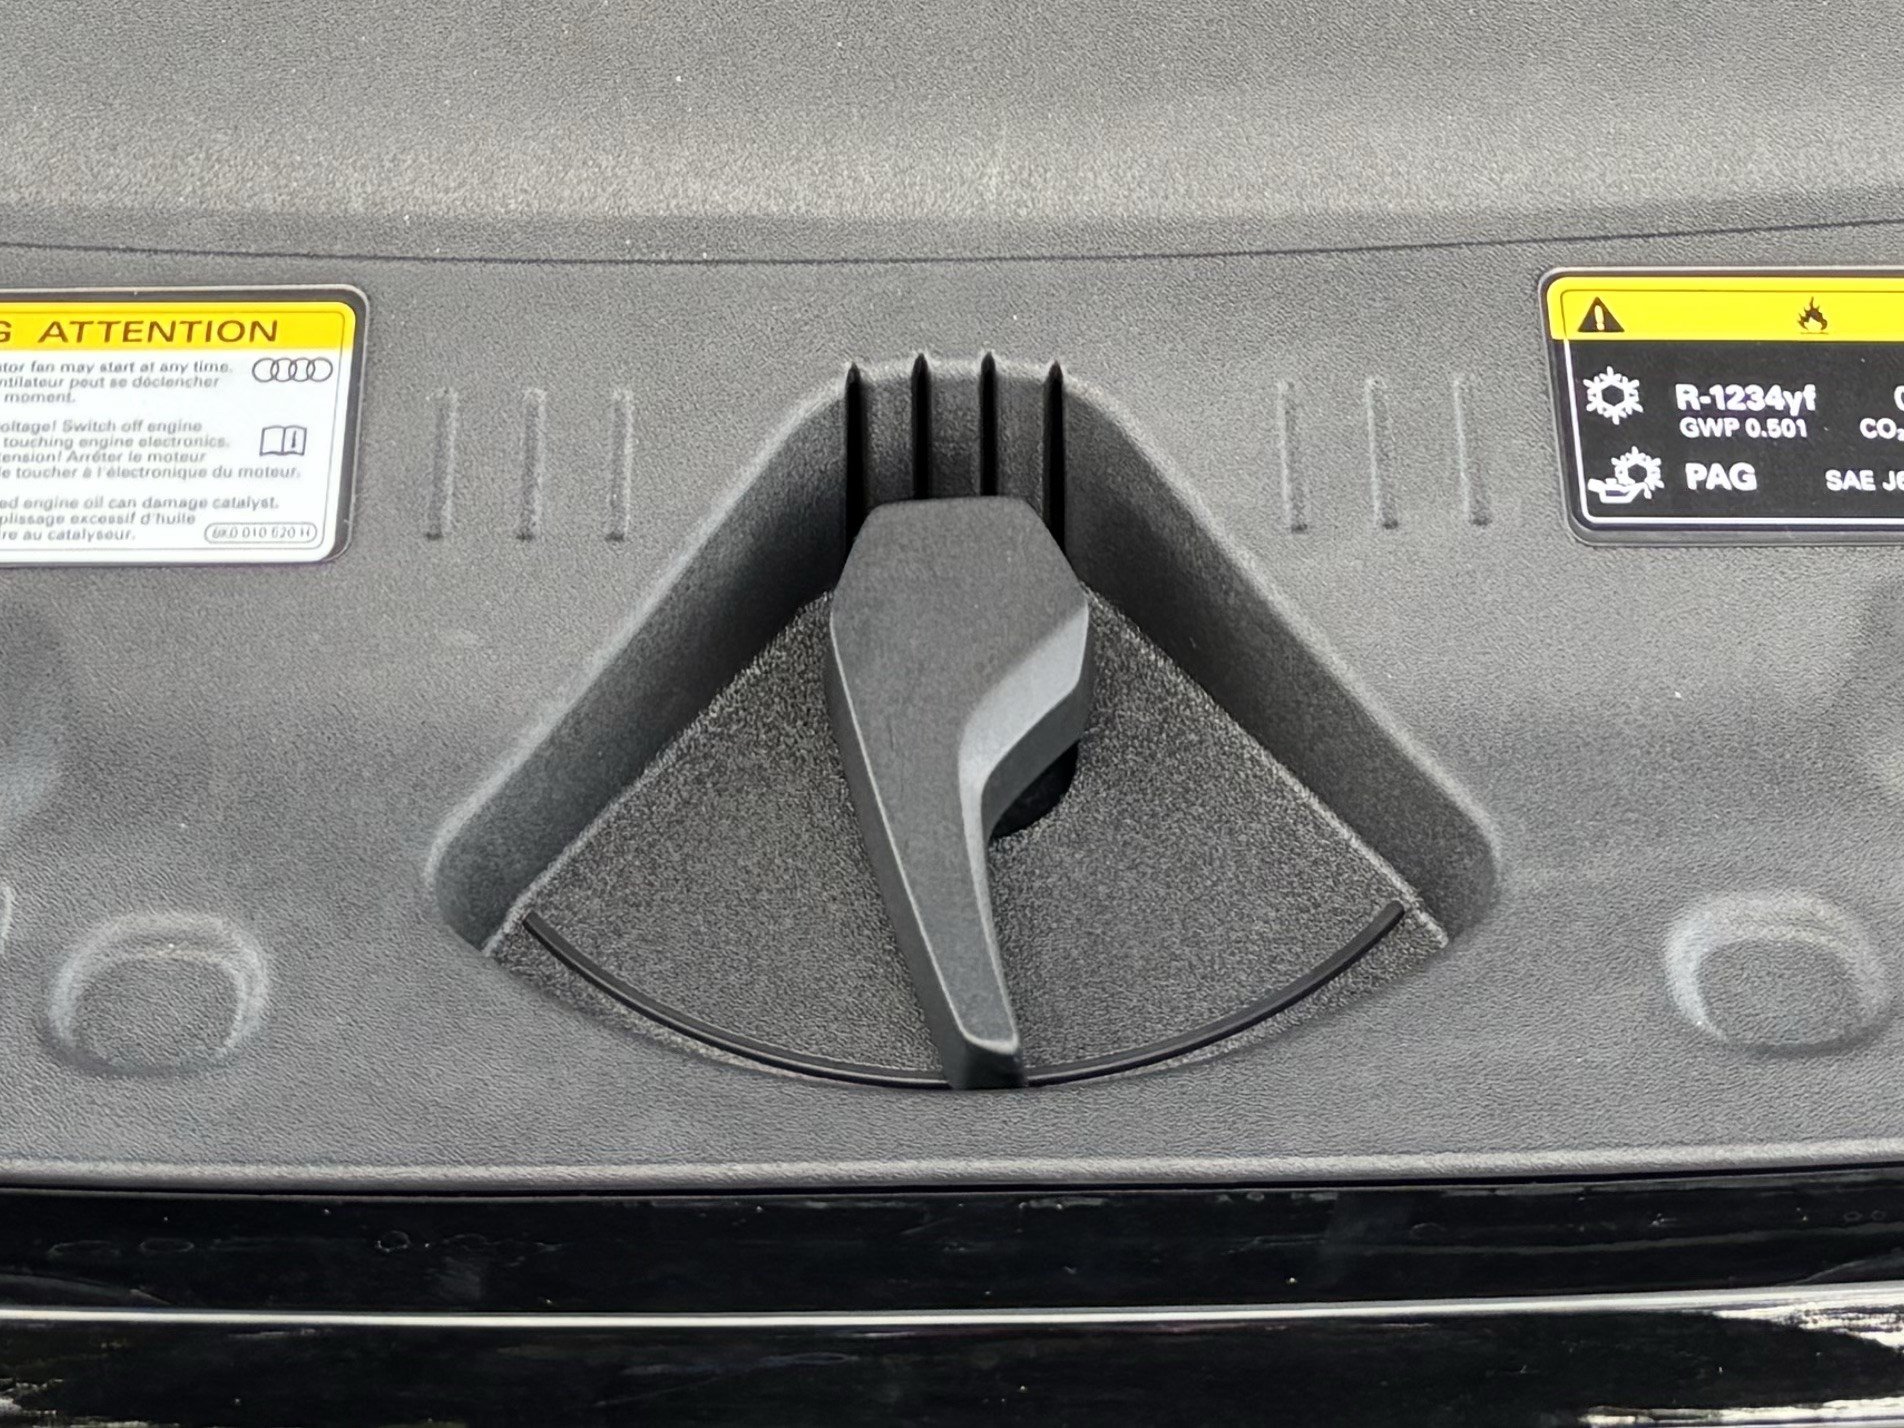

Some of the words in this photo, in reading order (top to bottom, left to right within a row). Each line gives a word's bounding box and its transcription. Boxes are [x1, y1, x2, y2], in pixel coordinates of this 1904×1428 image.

[37, 319, 278, 343] ATTENTION
[30, 360, 56, 374] fan
[60, 362, 94, 376] may
[99, 361, 135, 374] start
[139, 361, 155, 374] at
[159, 362, 190, 376] any
[193, 360, 234, 374] time.
[1674, 384, 1817, 418] R-1234yf
[62, 420, 117, 433] Switch
[121, 419, 144, 433] off
[147, 419, 203, 436] engine
[1678, 418, 1741, 439] GWP
[1744, 419, 1808, 439] 0.501
[1684, 463, 1758, 492] PAG
[1824, 470, 1876, 493] SAE
[22, 496, 80, 513] engine
[82, 495, 105, 511] oil
[108, 497, 138, 511] can
[141, 496, 209, 513] damage
[212, 495, 281, 513] catalyst.
